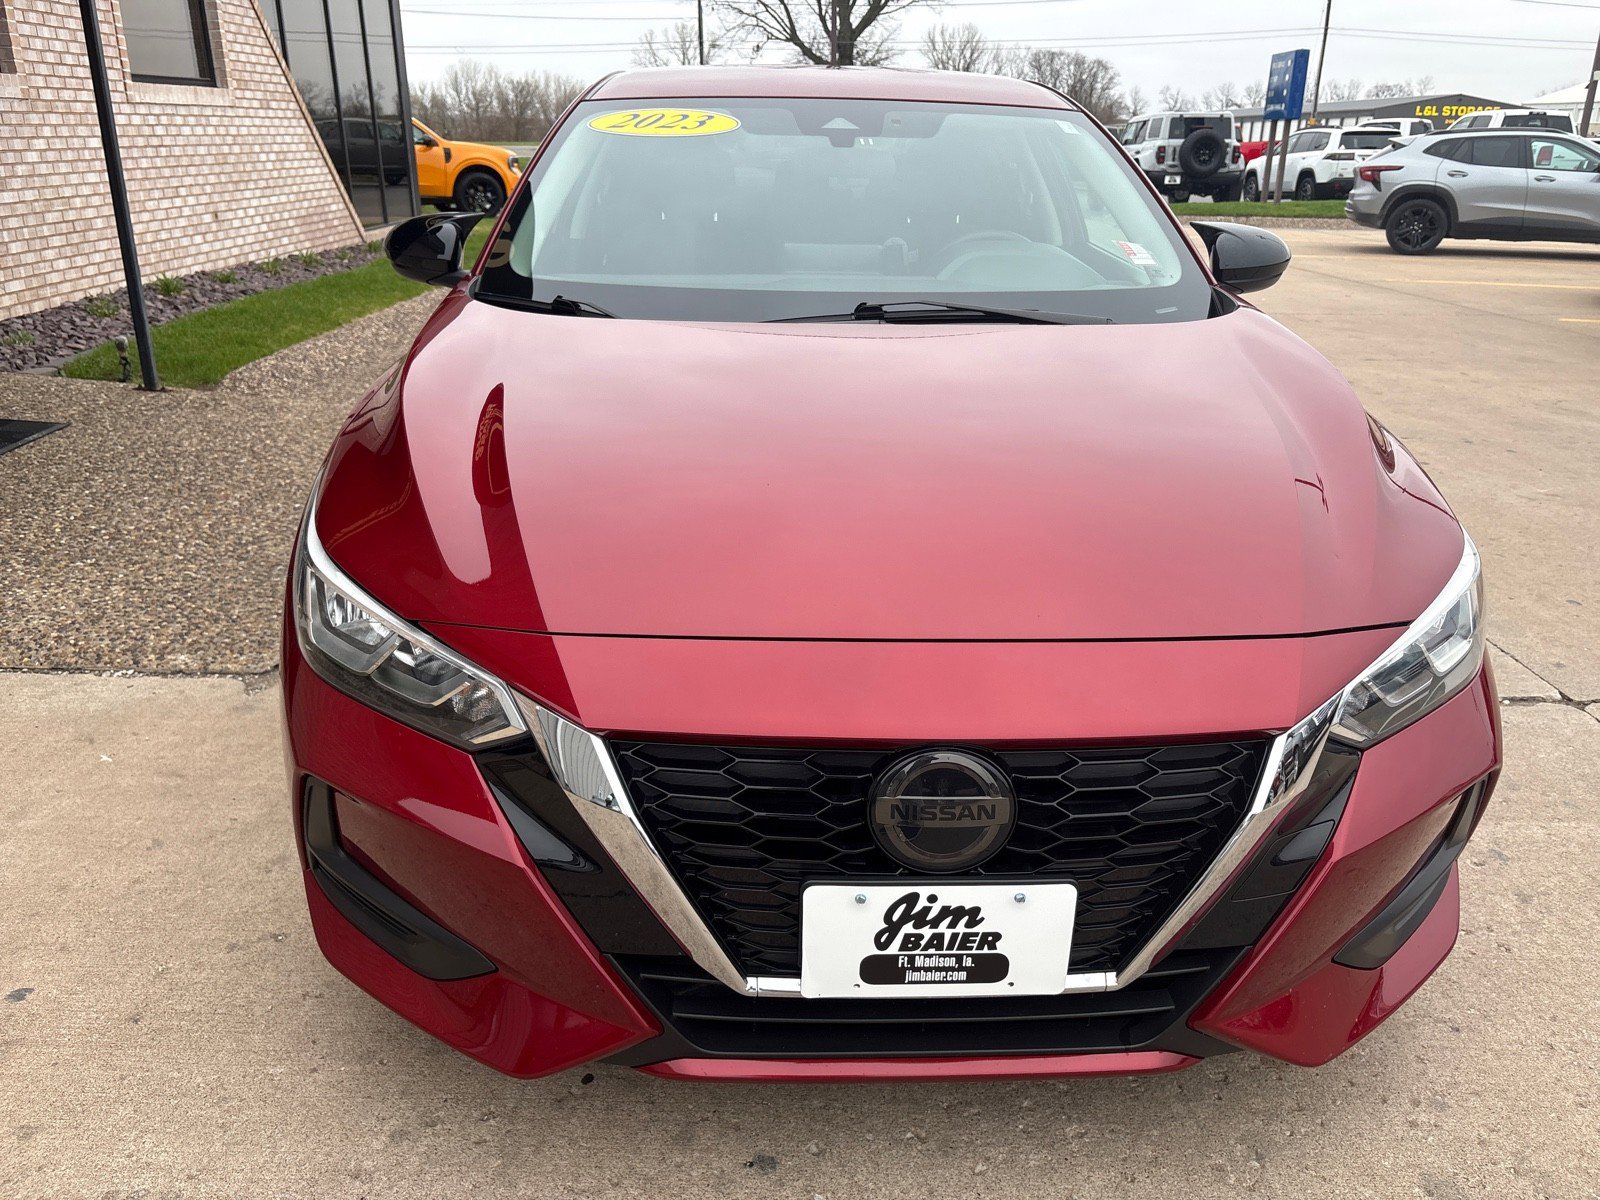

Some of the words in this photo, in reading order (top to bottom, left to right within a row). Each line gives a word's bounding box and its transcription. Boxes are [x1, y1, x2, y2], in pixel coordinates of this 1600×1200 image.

[1415, 105, 1439, 116] L&L
[606, 113, 715, 130] 2023
[890, 803, 996, 821] NISSAN
[873, 891, 985, 951] Jim
[897, 931, 1003, 952] BAIER
[898, 955, 911, 967] Ft.
[914, 955, 959, 968] Madison,
[962, 955, 975, 967] Ia.
[904, 970, 967, 984] jimbaier.com
